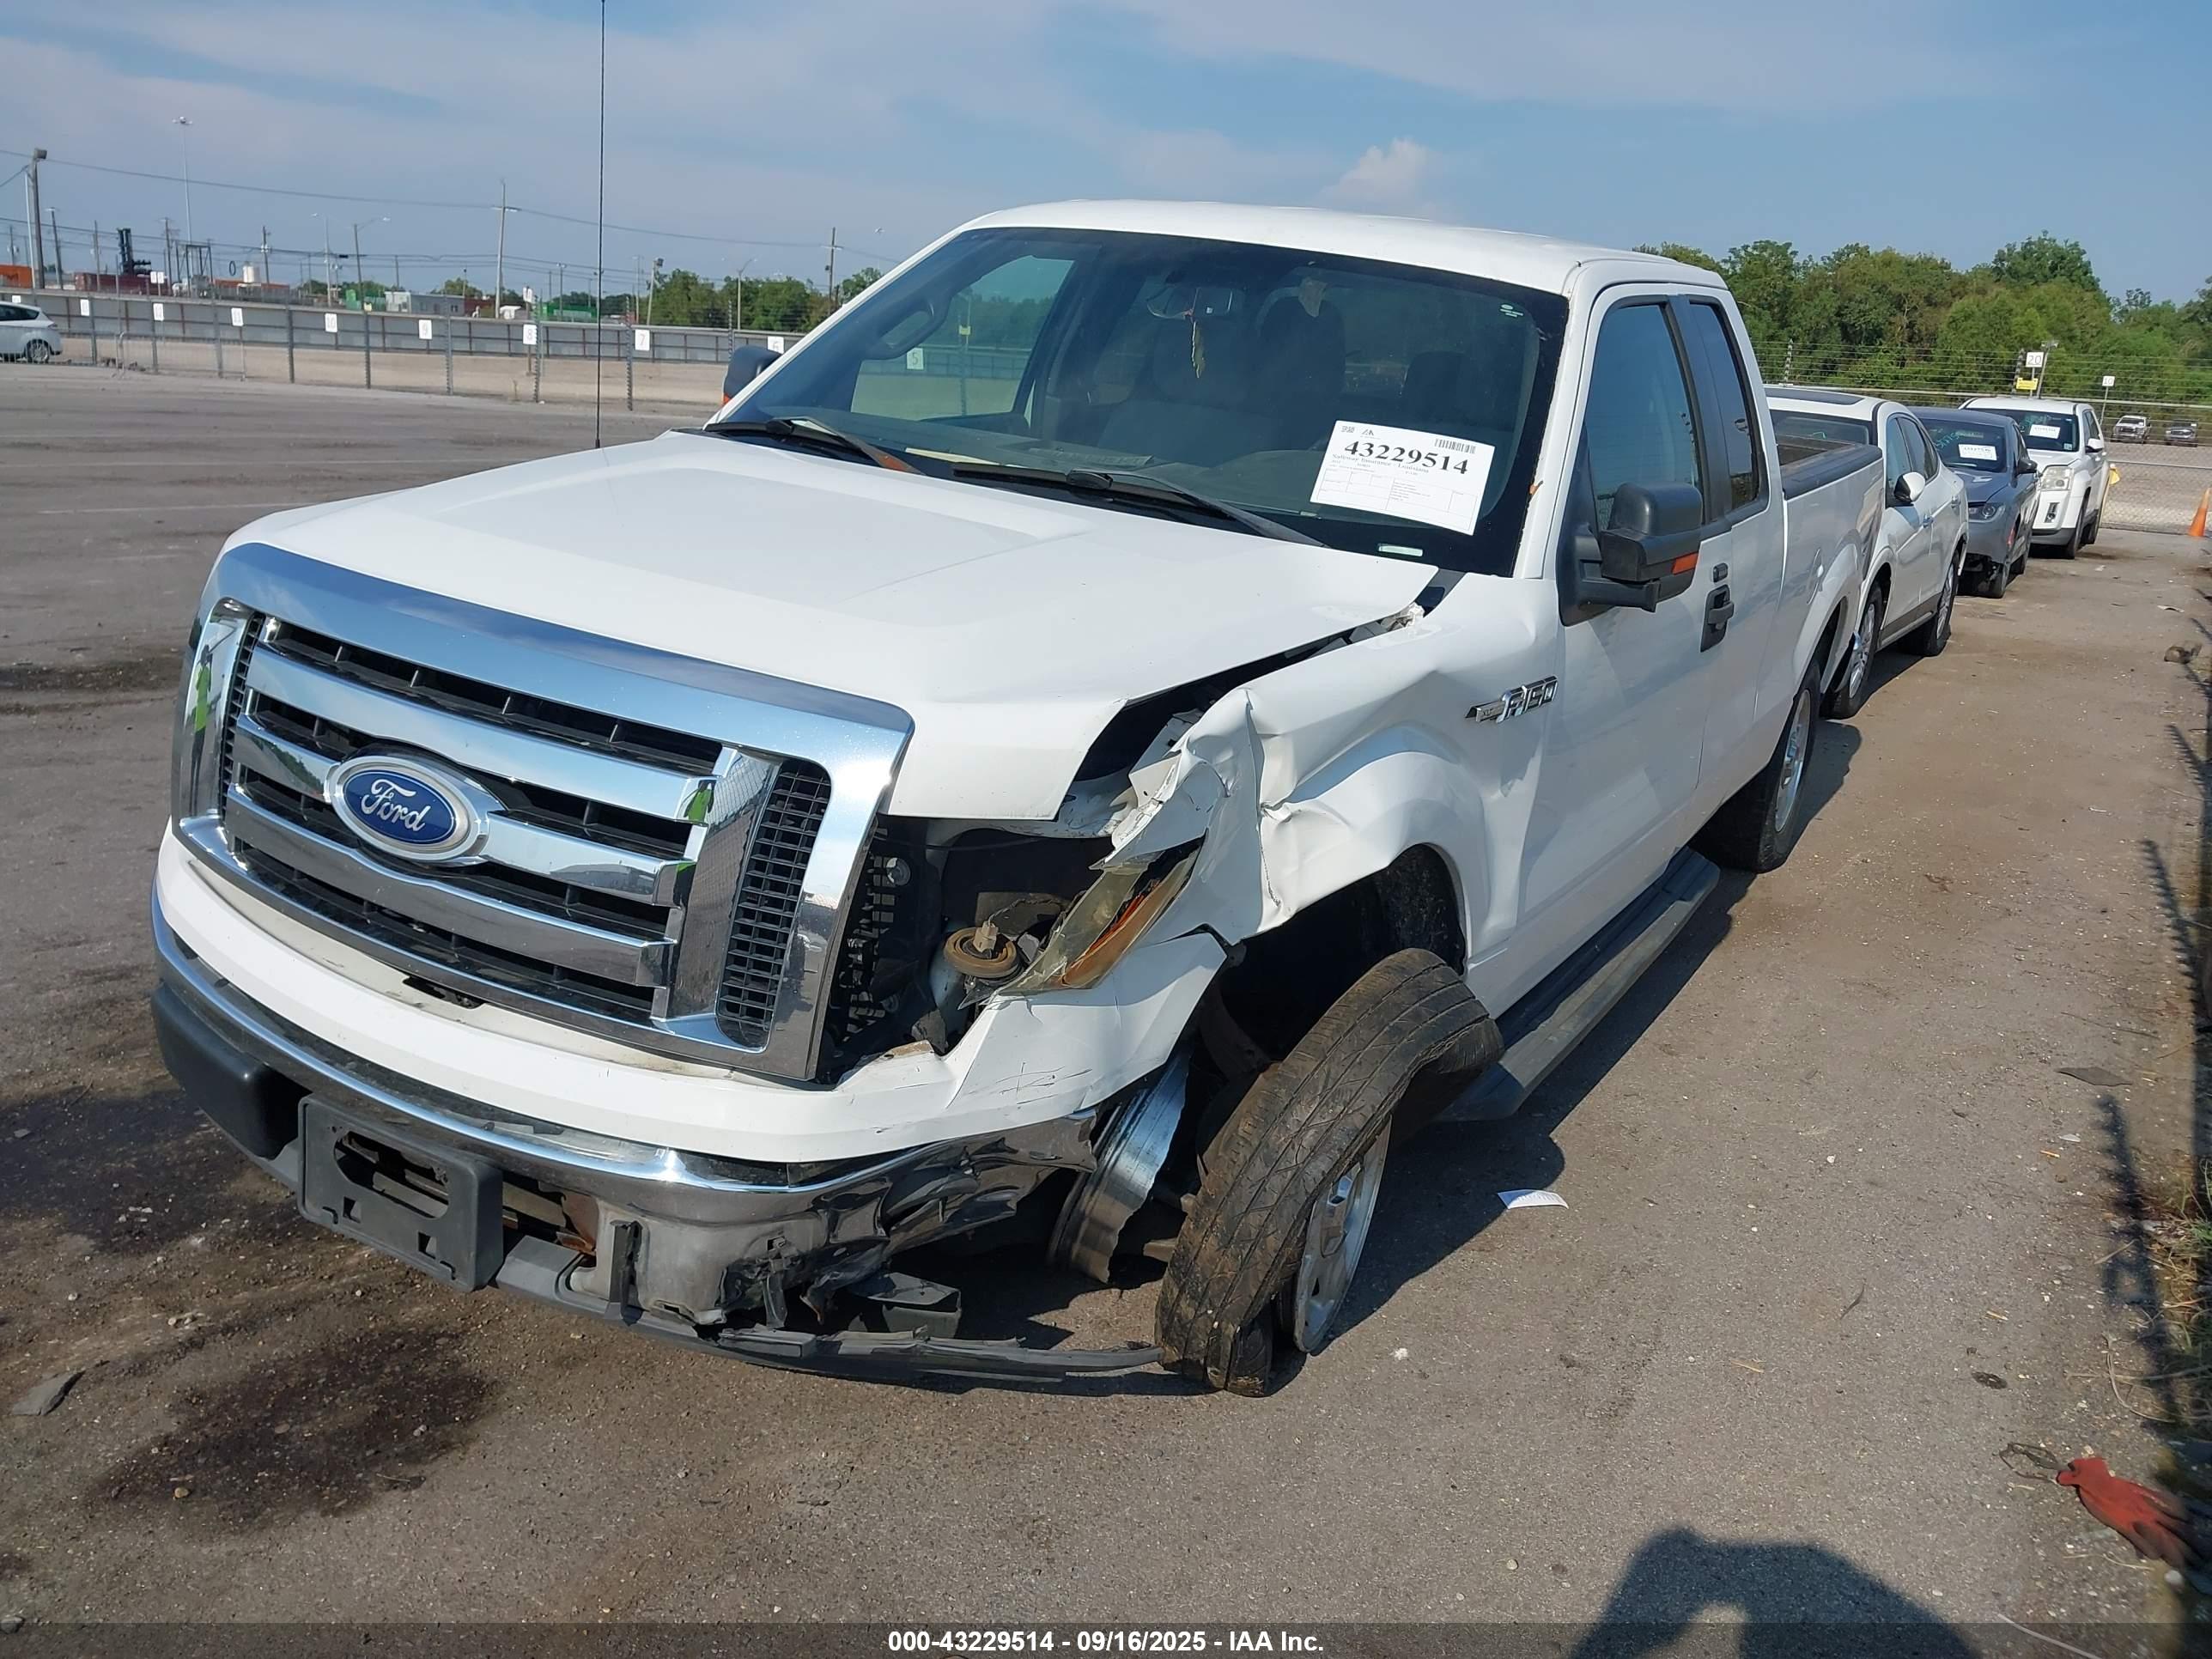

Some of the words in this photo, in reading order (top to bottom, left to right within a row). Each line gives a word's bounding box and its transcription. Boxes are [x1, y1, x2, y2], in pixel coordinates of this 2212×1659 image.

[639, 333, 646, 346] 7
[912, 352, 919, 365] 5
[2027, 355, 2042, 365] 20
[1344, 441, 1468, 474] 43229514
[361, 779, 431, 832] Ford
